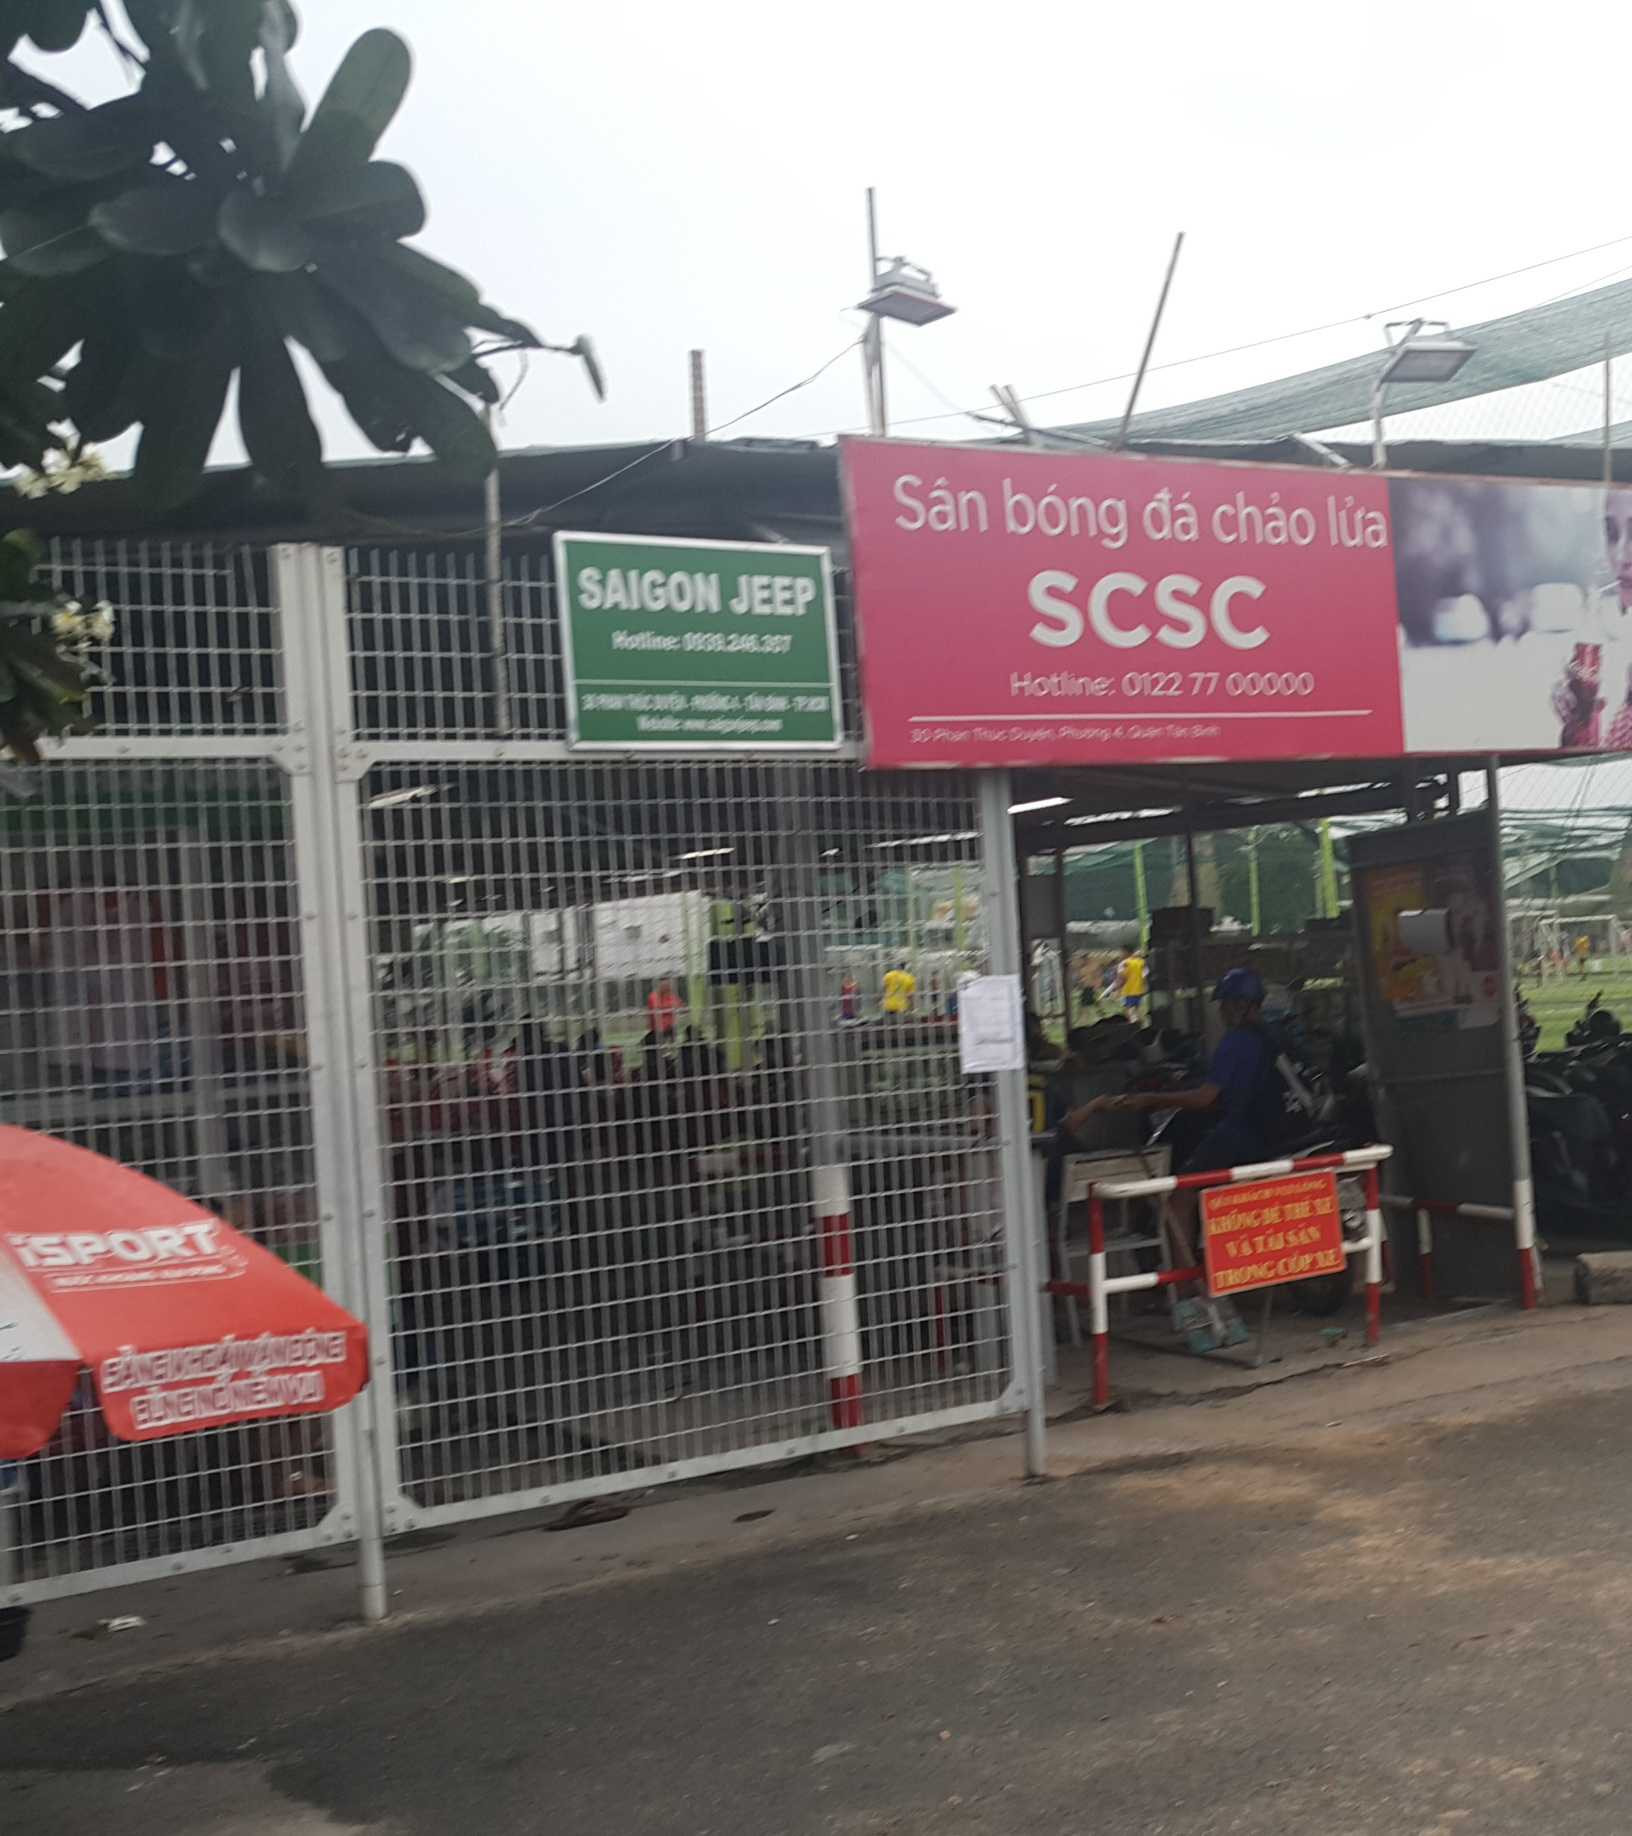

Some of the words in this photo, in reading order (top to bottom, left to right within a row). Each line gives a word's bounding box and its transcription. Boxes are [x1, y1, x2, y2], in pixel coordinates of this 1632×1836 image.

[892, 474, 988, 533] Sân
[1002, 478, 1129, 549] bóng
[1142, 486, 1199, 543] đá
[1211, 491, 1316, 547] chảo
[1328, 495, 1388, 549] lửa
[577, 566, 722, 614] SAIGON
[728, 573, 817, 616] JEEP
[1027, 568, 1271, 650] SCSC
[1009, 671, 1115, 697] Hotline:
[1120, 671, 1184, 697] 0122
[1187, 671, 1220, 696] 77
[1226, 671, 1314, 696] 00000
